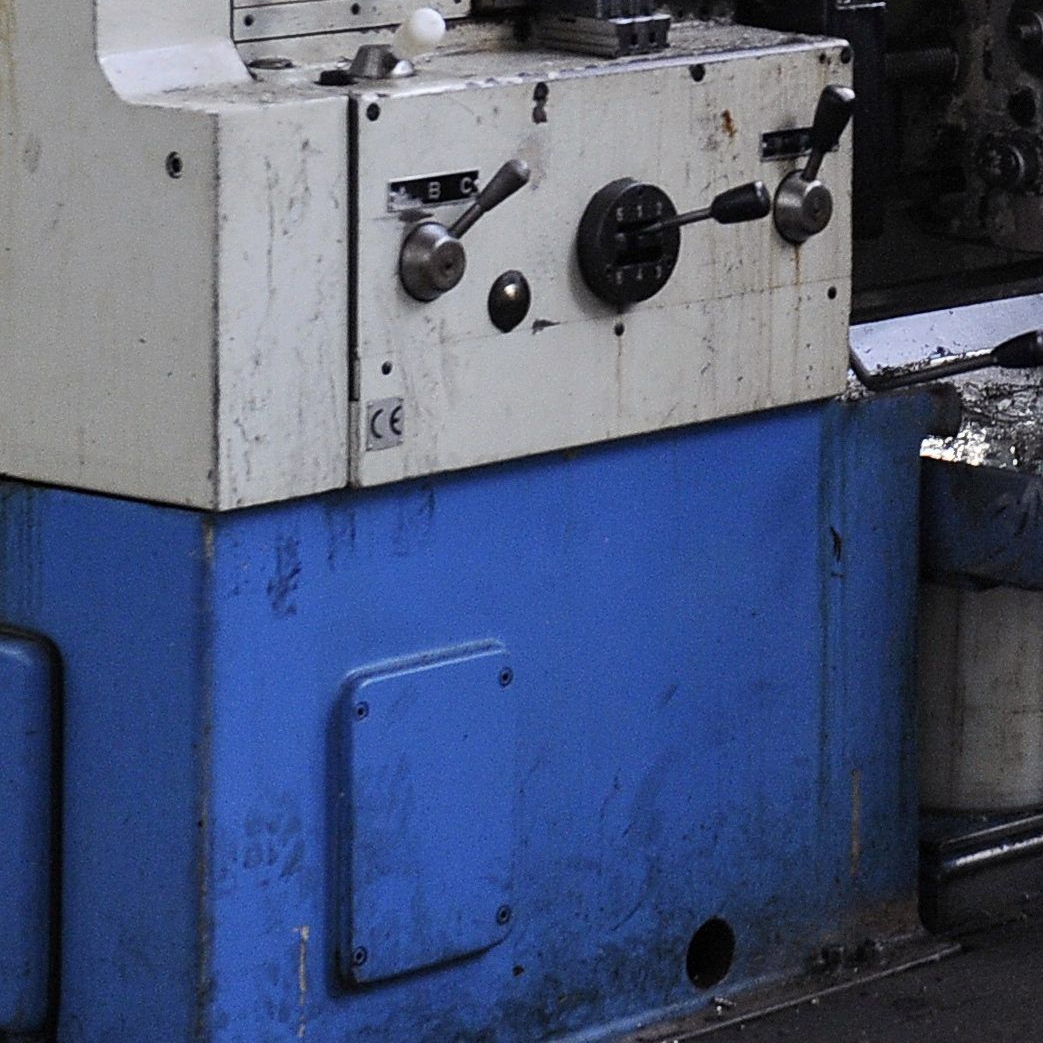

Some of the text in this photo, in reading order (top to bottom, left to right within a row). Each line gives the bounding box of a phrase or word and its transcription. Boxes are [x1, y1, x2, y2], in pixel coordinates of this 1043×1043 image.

[428, 181, 441, 199] B
[460, 176, 473, 194] C
[370, 405, 403, 439] CE
